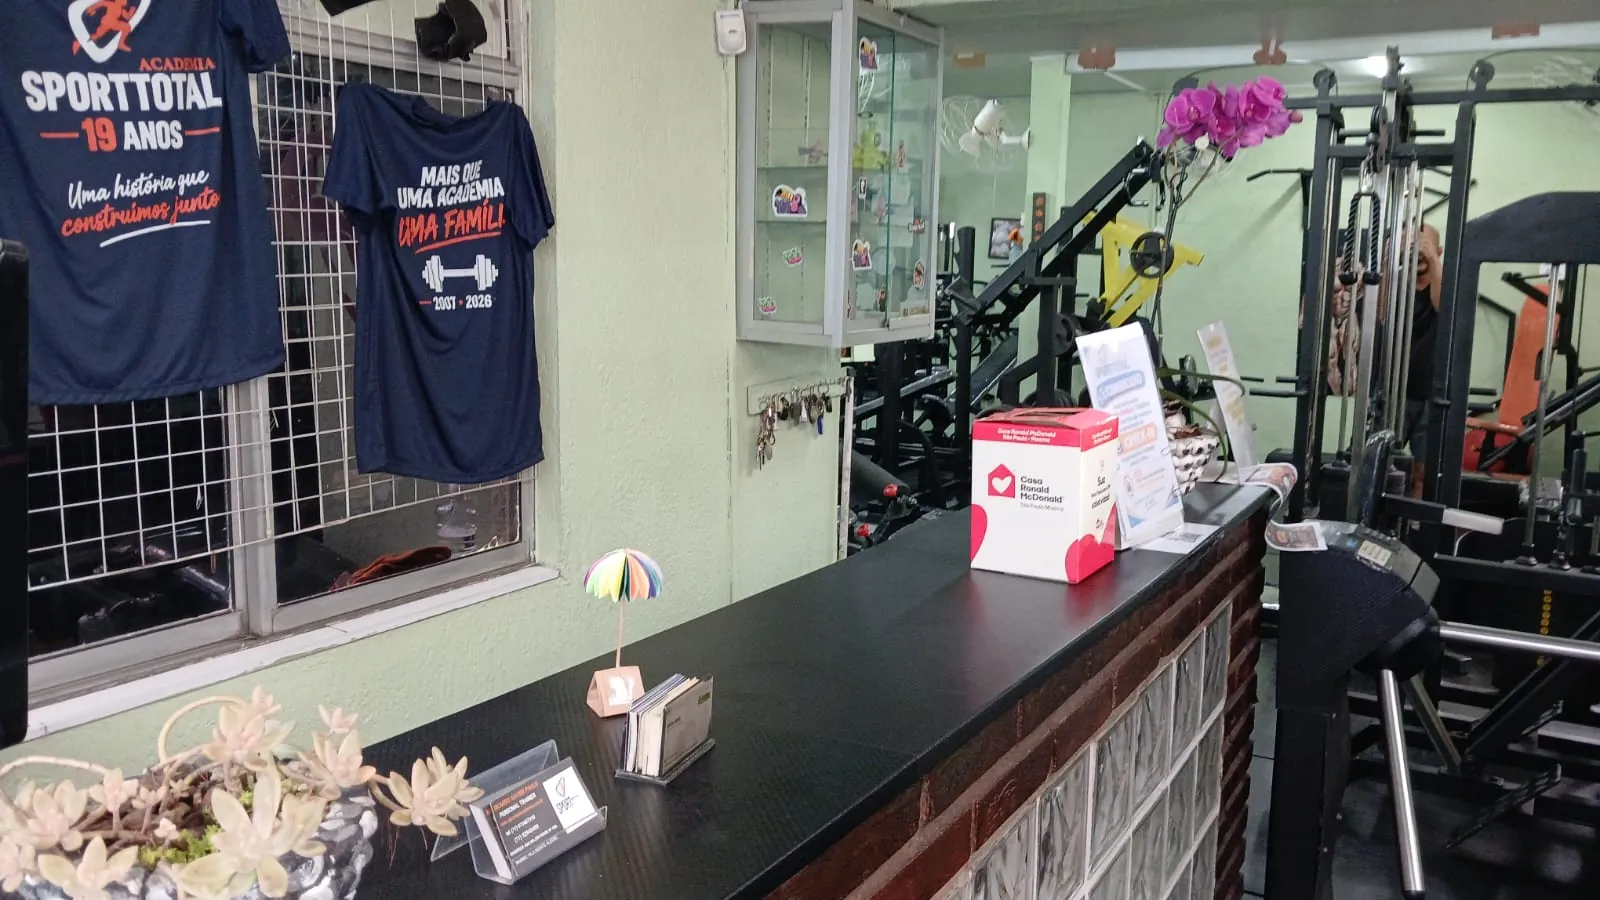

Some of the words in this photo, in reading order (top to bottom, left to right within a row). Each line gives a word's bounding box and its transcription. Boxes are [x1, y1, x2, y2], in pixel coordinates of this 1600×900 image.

[139, 57, 216, 72] ACADEMIA
[21, 71, 223, 112] SPORTTOTAL
[81, 117, 118, 152] 19
[123, 120, 184, 151] ANOS
[420, 164, 461, 187] MAIS
[463, 160, 483, 183] QUE
[68, 180, 111, 209] Uma
[113, 172, 176, 198] história
[177, 169, 209, 190] que
[397, 187, 434, 210] UMA
[437, 176, 505, 207] ACADEMIA
[61, 202, 171, 237] construímos
[170, 186, 221, 225] junto
[399, 213, 439, 248] UMA
[444, 198, 506, 239] FAMÍLI
[433, 296, 457, 310] 2007
[465, 294, 493, 309] 2026
[1020, 476, 1043, 484] Casa
[1020, 484, 1050, 493] Ronald
[1020, 492, 1063, 503] McDonald
